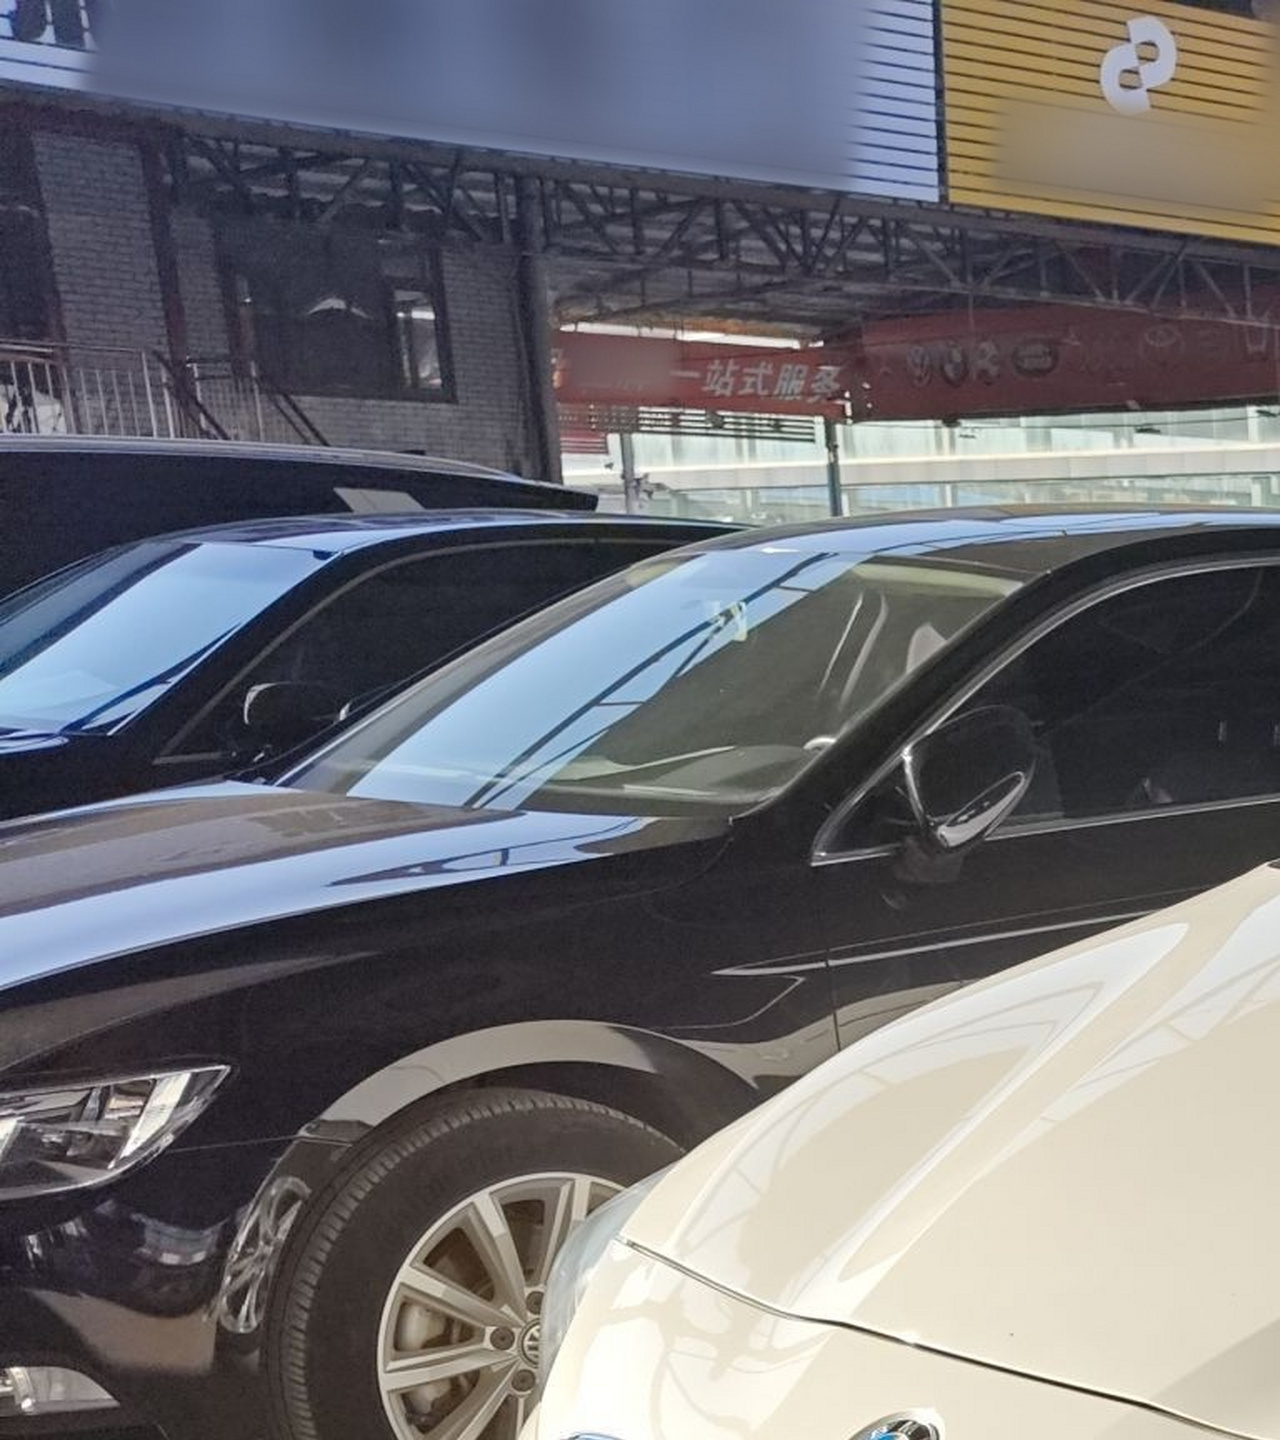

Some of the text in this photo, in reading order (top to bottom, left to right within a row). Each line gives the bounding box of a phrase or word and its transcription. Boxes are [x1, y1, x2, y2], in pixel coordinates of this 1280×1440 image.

[670, 359, 841, 403] 一站式服务
